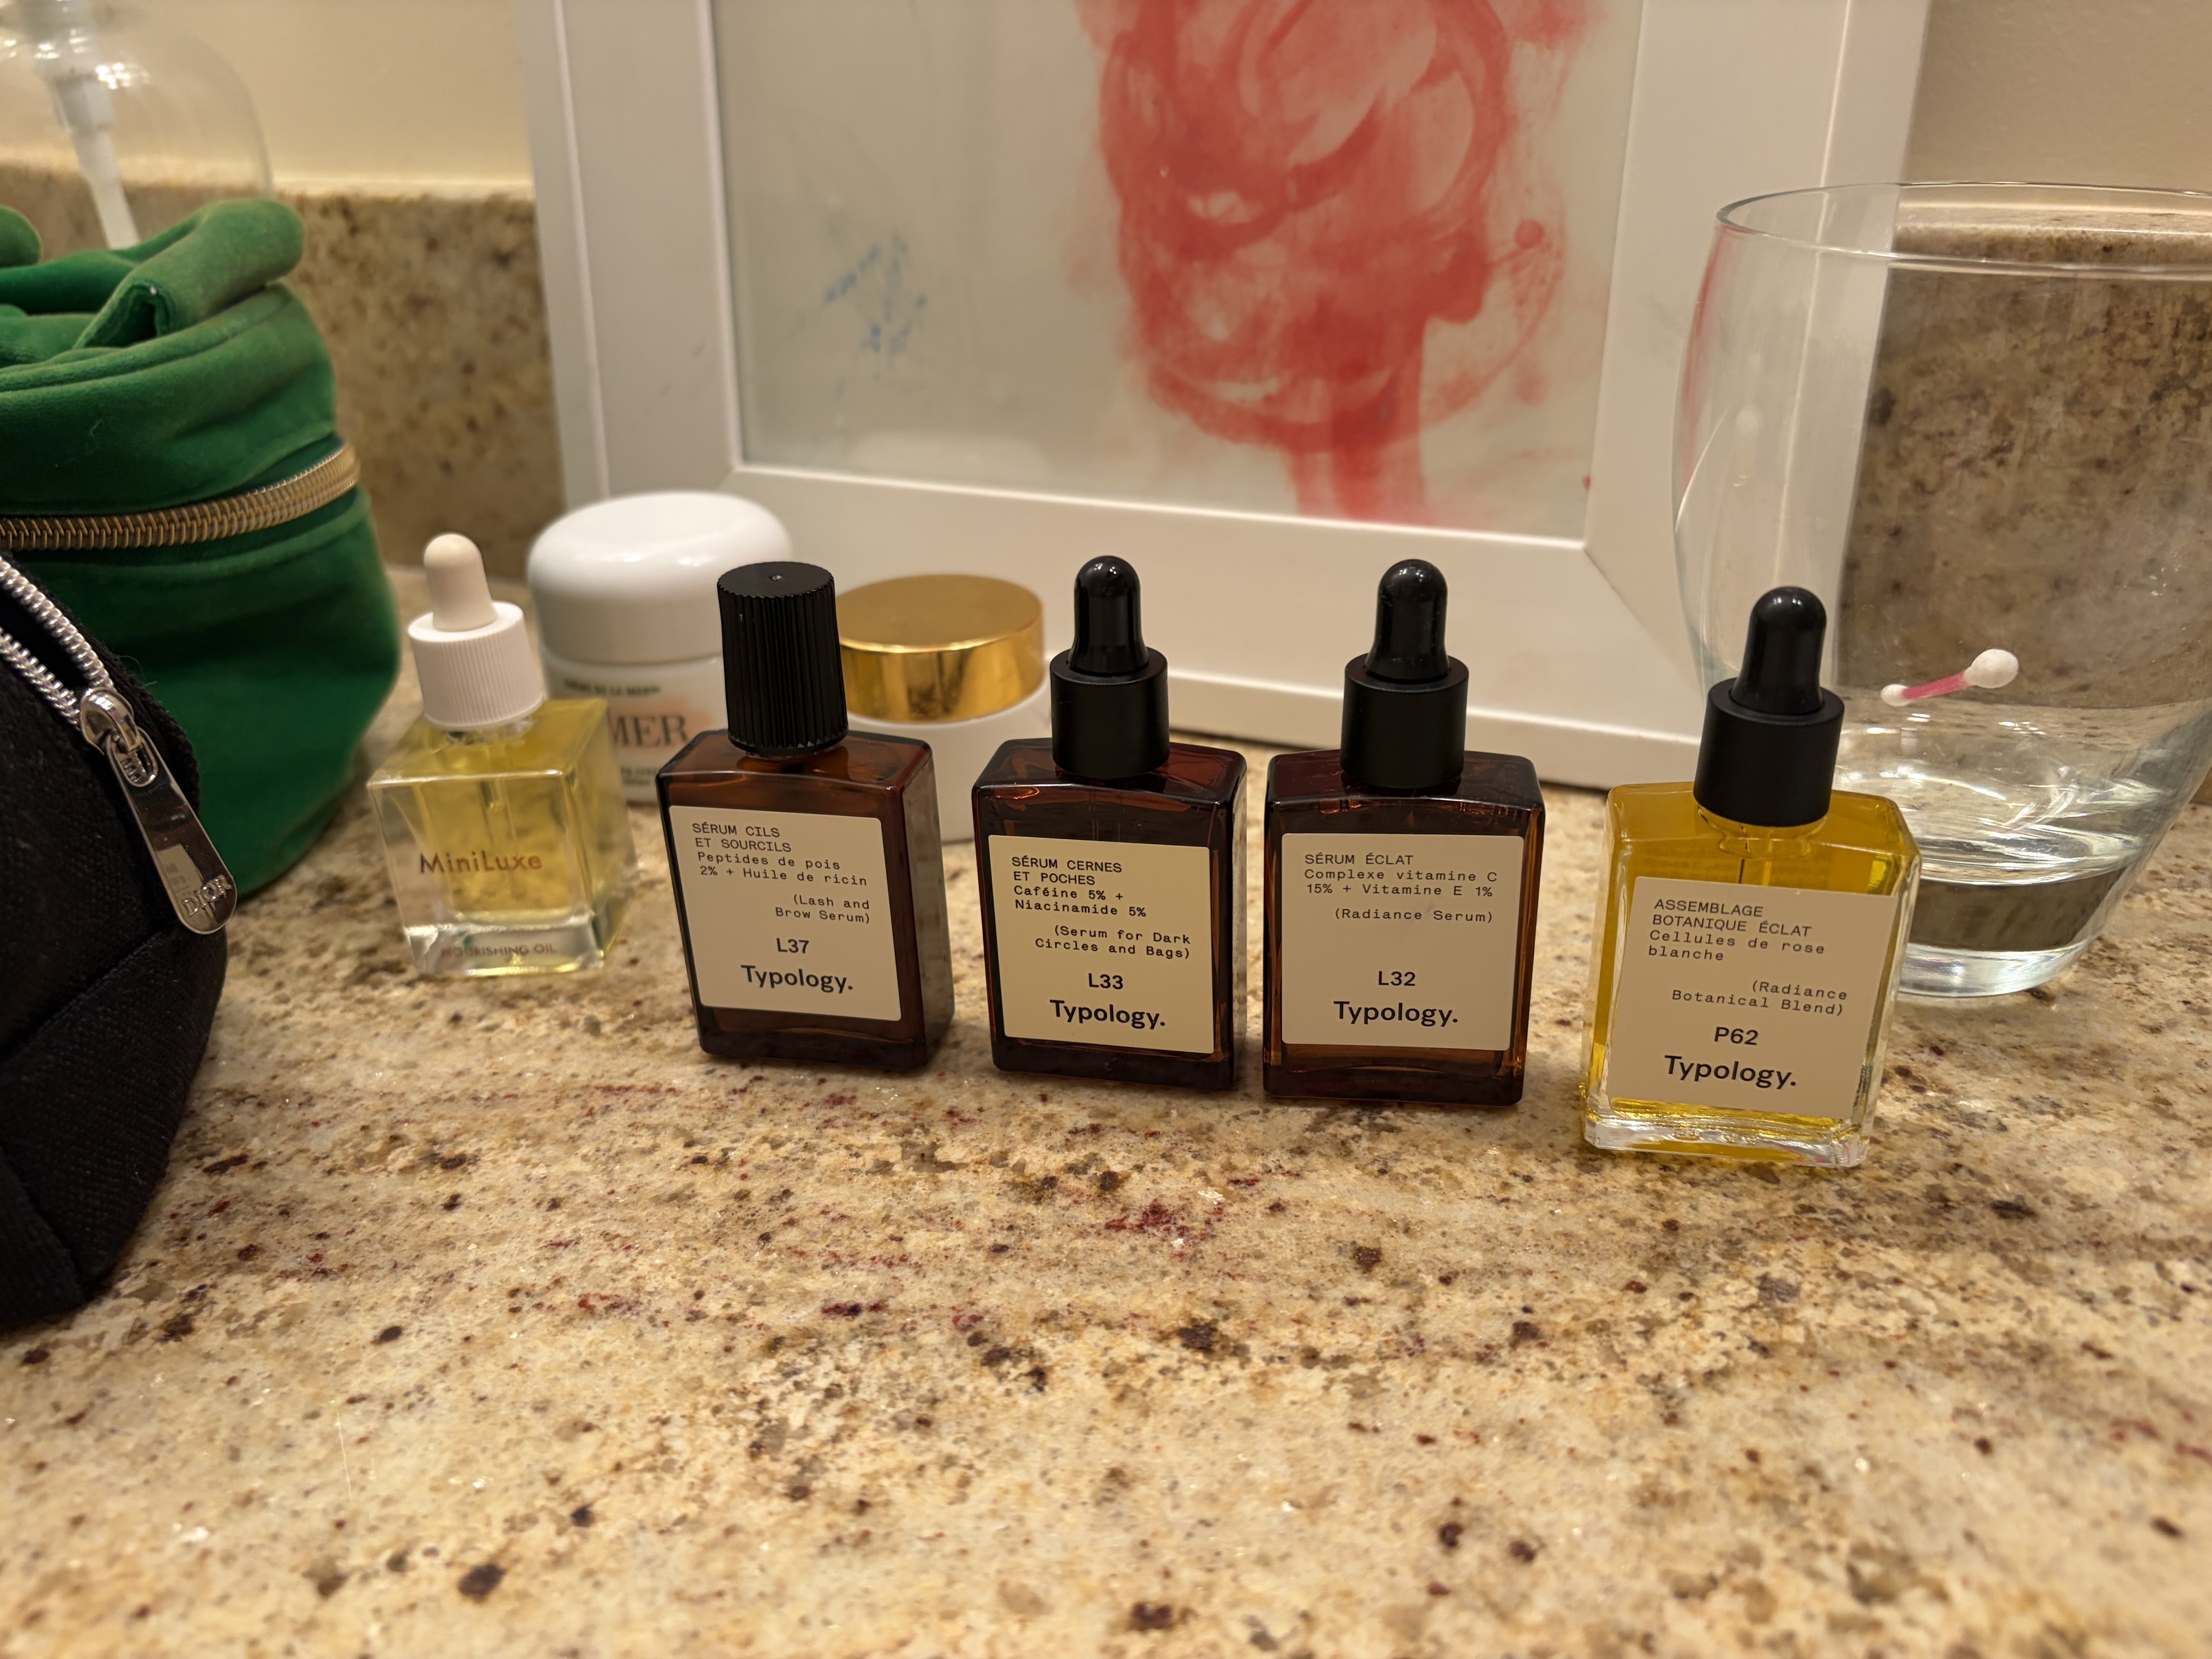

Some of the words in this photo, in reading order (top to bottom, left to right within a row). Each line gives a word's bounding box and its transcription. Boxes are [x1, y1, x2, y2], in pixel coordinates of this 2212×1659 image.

[606, 714, 688, 747] MER
[692, 821, 737, 835] SÉRUM
[745, 826, 780, 838] CILS
[695, 837, 711, 848] ET
[721, 838, 792, 853] SOURCILS
[421, 850, 542, 874] MiniLuxe
[697, 851, 768, 865] Peptides
[778, 856, 795, 867] de
[805, 859, 840, 870] pois
[1012, 855, 1058, 869] SÉRUM
[1066, 860, 1122, 873] CERNES
[1305, 852, 1355, 864] SÉRUM
[1365, 852, 1414, 865] ÉCLAT
[700, 865, 718, 876] 2%
[743, 867, 787, 880] Huile
[797, 871, 814, 882] de
[824, 874, 867, 886] ricin
[1013, 871, 1030, 881] ET
[1040, 872, 1096, 886] POCHES
[1304, 869, 1384, 881] Complexe
[1396, 870, 1476, 881] vitamine
[1487, 872, 1497, 882] C
[182, 874, 232, 917] DIOR
[1013, 885, 1077, 899] Caféine
[1088, 890, 1106, 901] 5%
[1307, 883, 1333, 894] 15%
[1362, 884, 1442, 895] Vitamine
[1453, 885, 1462, 896] E
[1475, 886, 1493, 897] 1%
[793, 894, 834, 907] (Lash
[843, 900, 870, 910] and
[1015, 899, 1118, 915] Niacinamide
[1128, 906, 1147, 917] 5%
[1654, 898, 1764, 917] ASSEMBLAGE
[775, 907, 811, 919] Brow
[819, 910, 869, 924] Serum)
[1335, 908, 1422, 920] (Radiance
[1433, 910, 1492, 923] Serum)
[1054, 924, 1108, 938] (Serum
[1117, 929, 1143, 941] for
[1153, 932, 1190, 945] Dark
[1652, 914, 1747, 932] BOTANIQUE
[1759, 920, 1812, 937] ÉCLAT
[534, 943, 557, 955] OIL
[776, 937, 809, 954] L37
[1035, 938, 1098, 952] Circles
[1108, 945, 1135, 955] and
[1146, 945, 1190, 960] Bags)
[1650, 929, 1735, 946] Cellules
[1748, 937, 1768, 949] de
[1782, 942, 1824, 954] rose
[1648, 945, 1724, 961] blanche
[740, 964, 853, 994] Typology.
[1088, 972, 1124, 990] L33
[1378, 970, 1416, 986] L32
[1752, 980, 1847, 1000] (Radiance
[1672, 989, 1769, 1008] Botanical
[1781, 999, 1843, 1016] Blend)
[1049, 999, 1166, 1030] Typology.
[1333, 1001, 1458, 1027] Typology.
[1714, 1026, 1759, 1046] P62
[1664, 1054, 1796, 1090] Typology.
